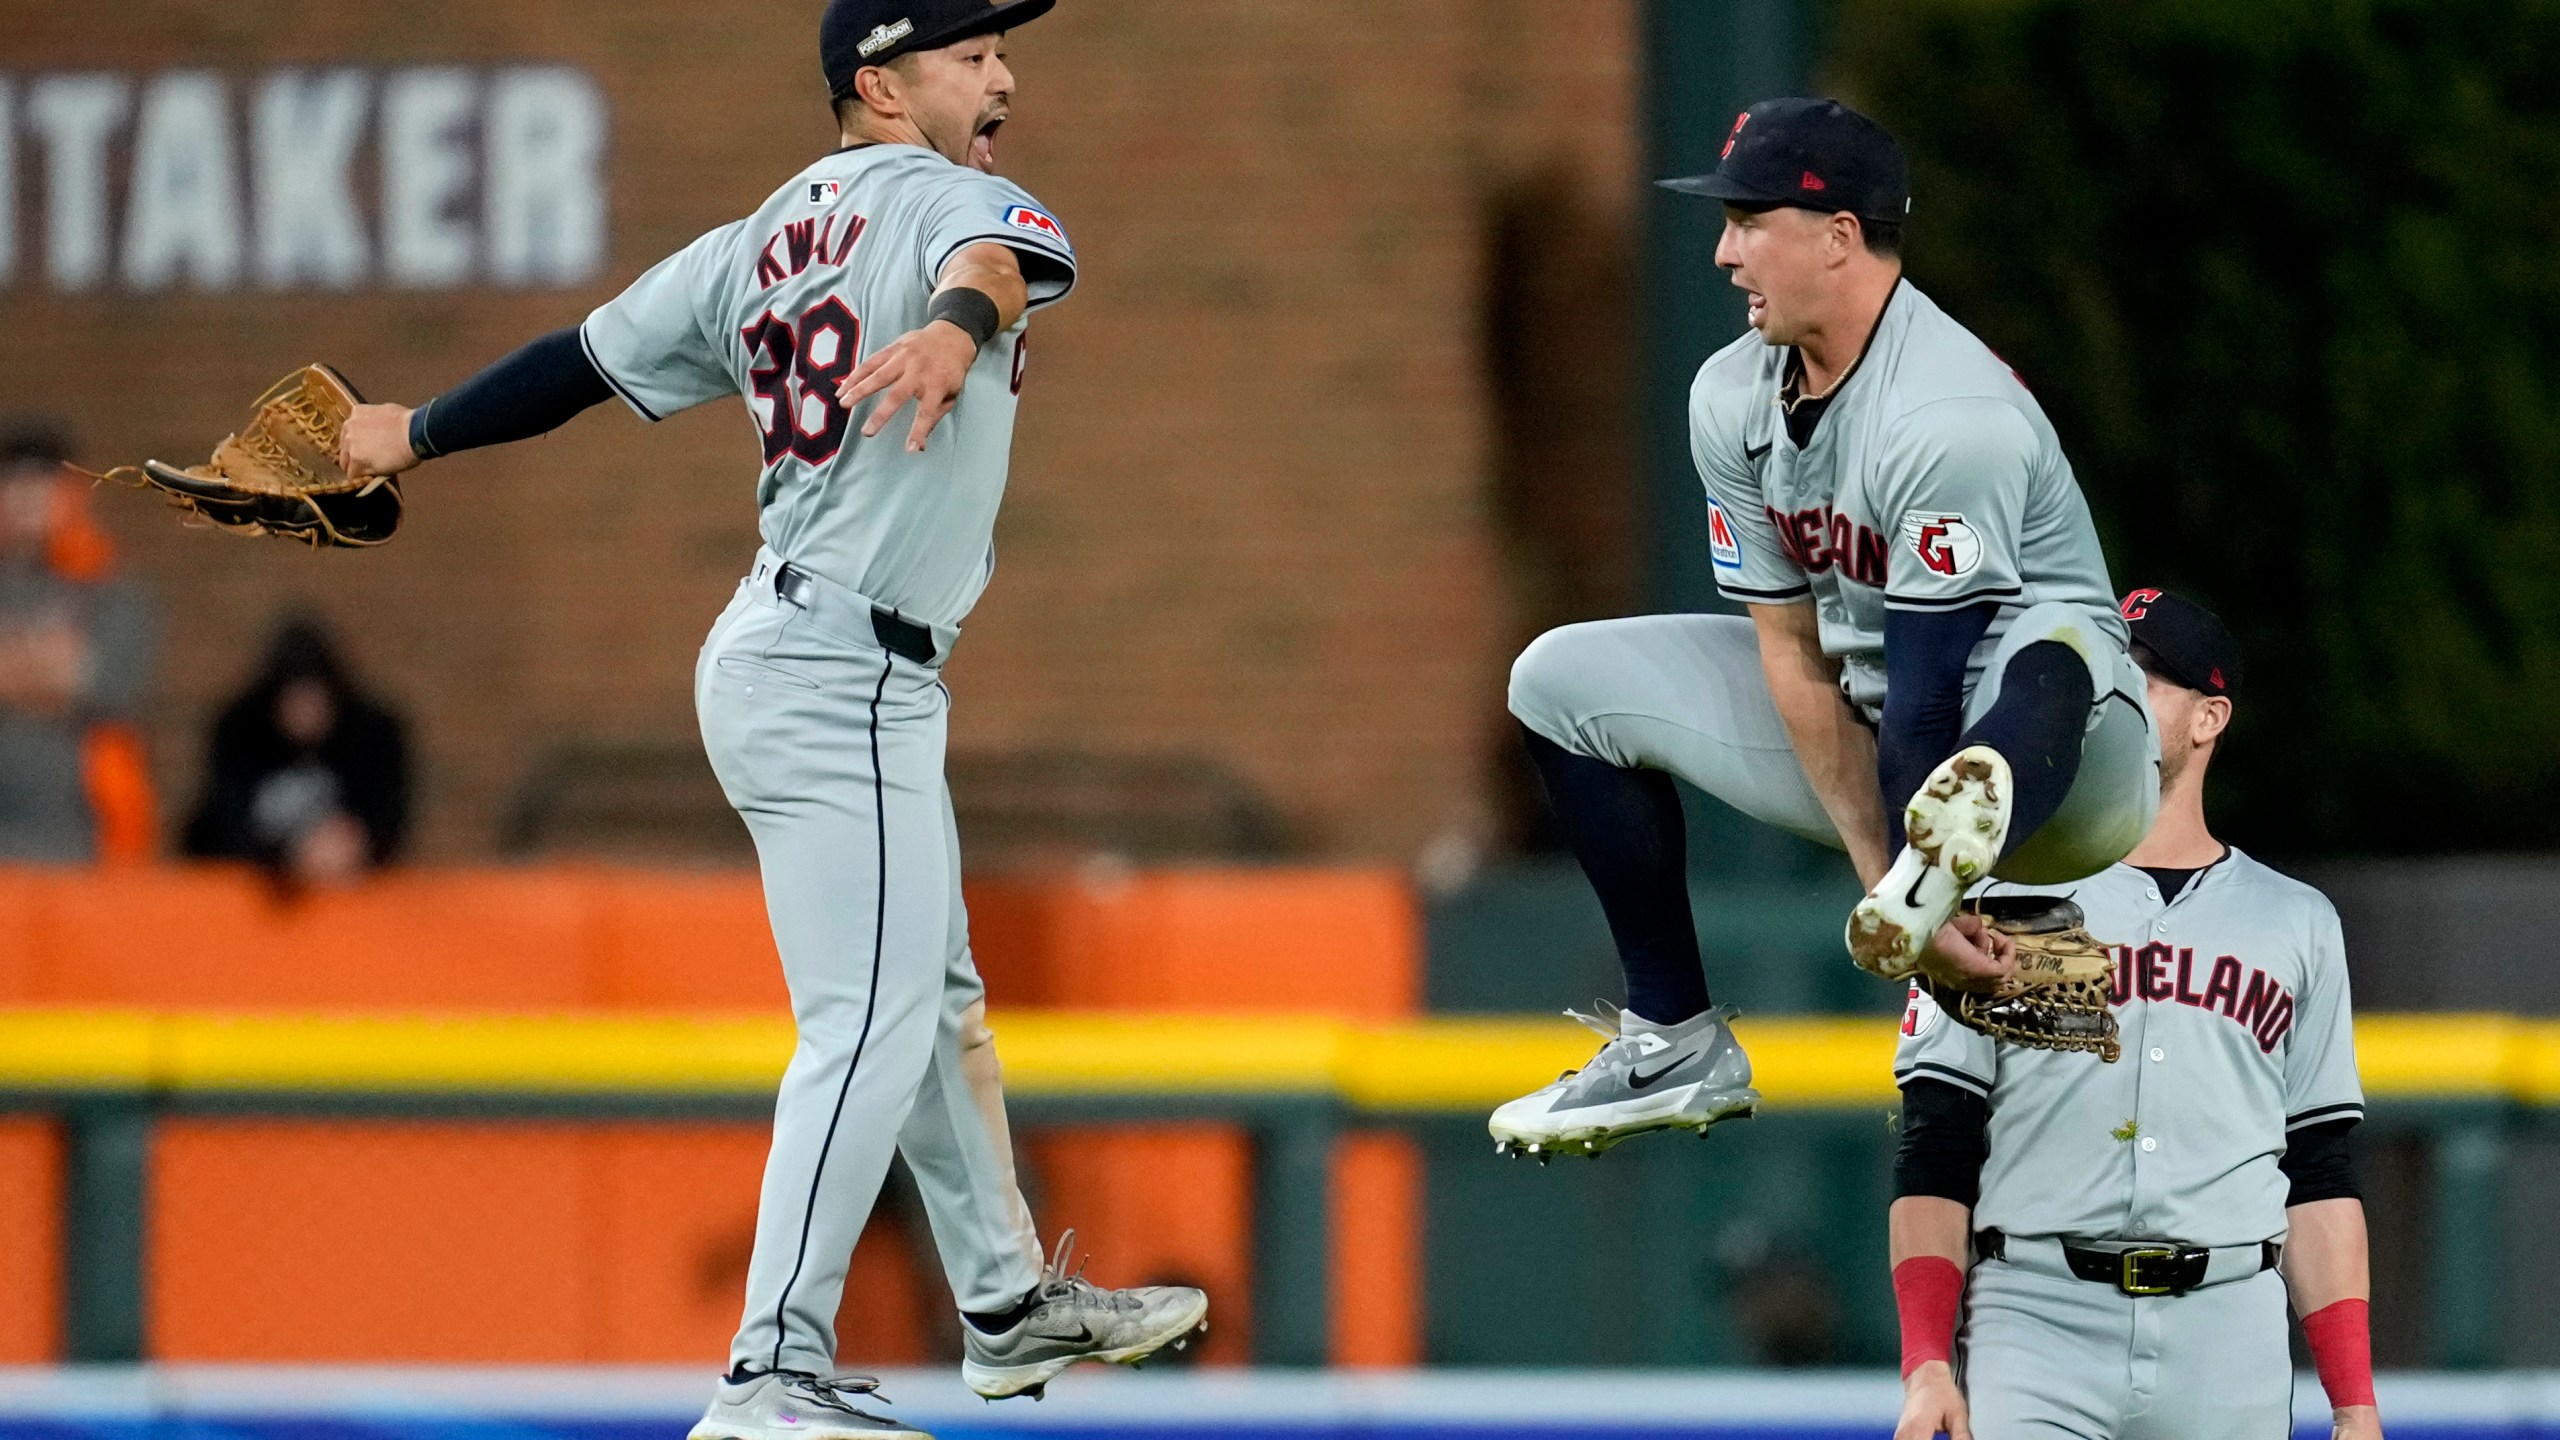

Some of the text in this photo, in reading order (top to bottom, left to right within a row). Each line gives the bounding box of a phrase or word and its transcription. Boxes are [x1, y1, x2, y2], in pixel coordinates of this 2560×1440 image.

[0, 64, 609, 290] TAKER
[756, 213, 868, 290] KWAN
[740, 294, 861, 467] 38
[2120, 587, 2163, 621] C
